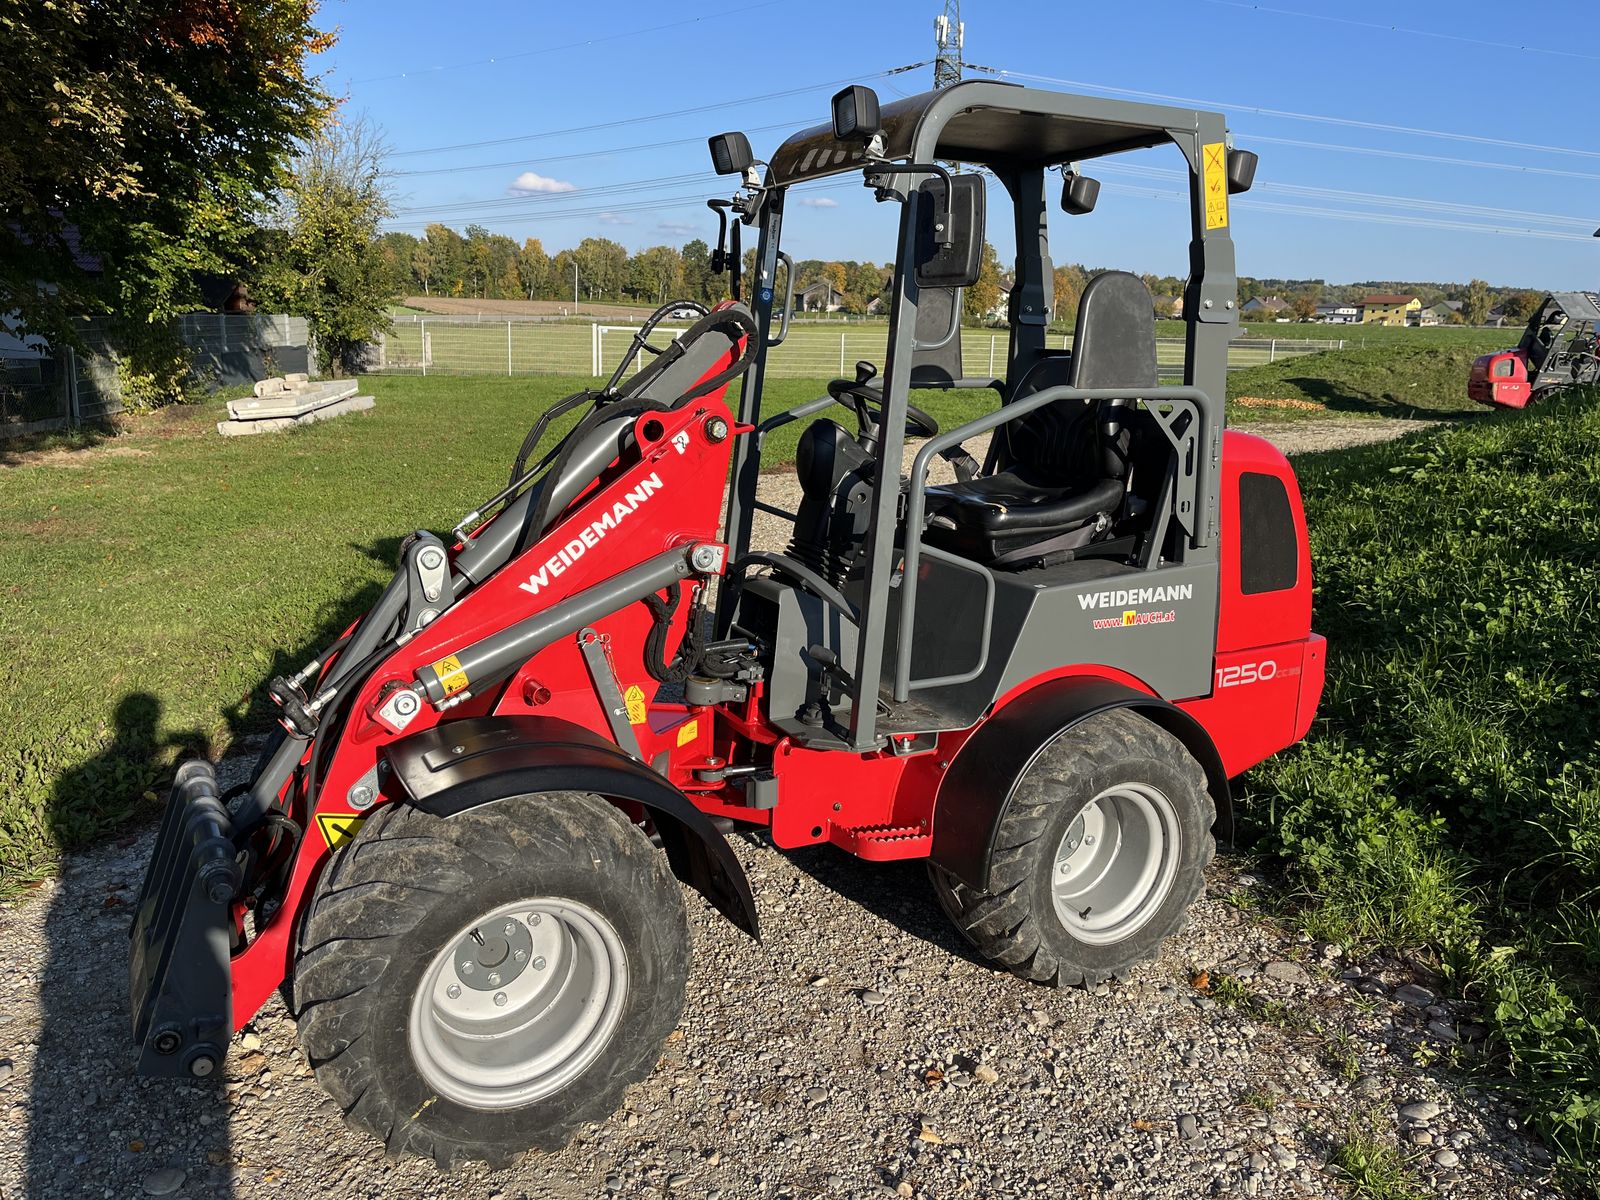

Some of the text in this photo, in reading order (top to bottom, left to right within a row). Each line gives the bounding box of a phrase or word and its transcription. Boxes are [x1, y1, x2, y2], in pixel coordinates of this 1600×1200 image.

[518, 472, 664, 595] WEIDEMANN
[1077, 584, 1193, 610] WEIDEMANN
[1093, 610, 1176, 629] www.MAUCH.at
[1215, 660, 1277, 689] 1250
